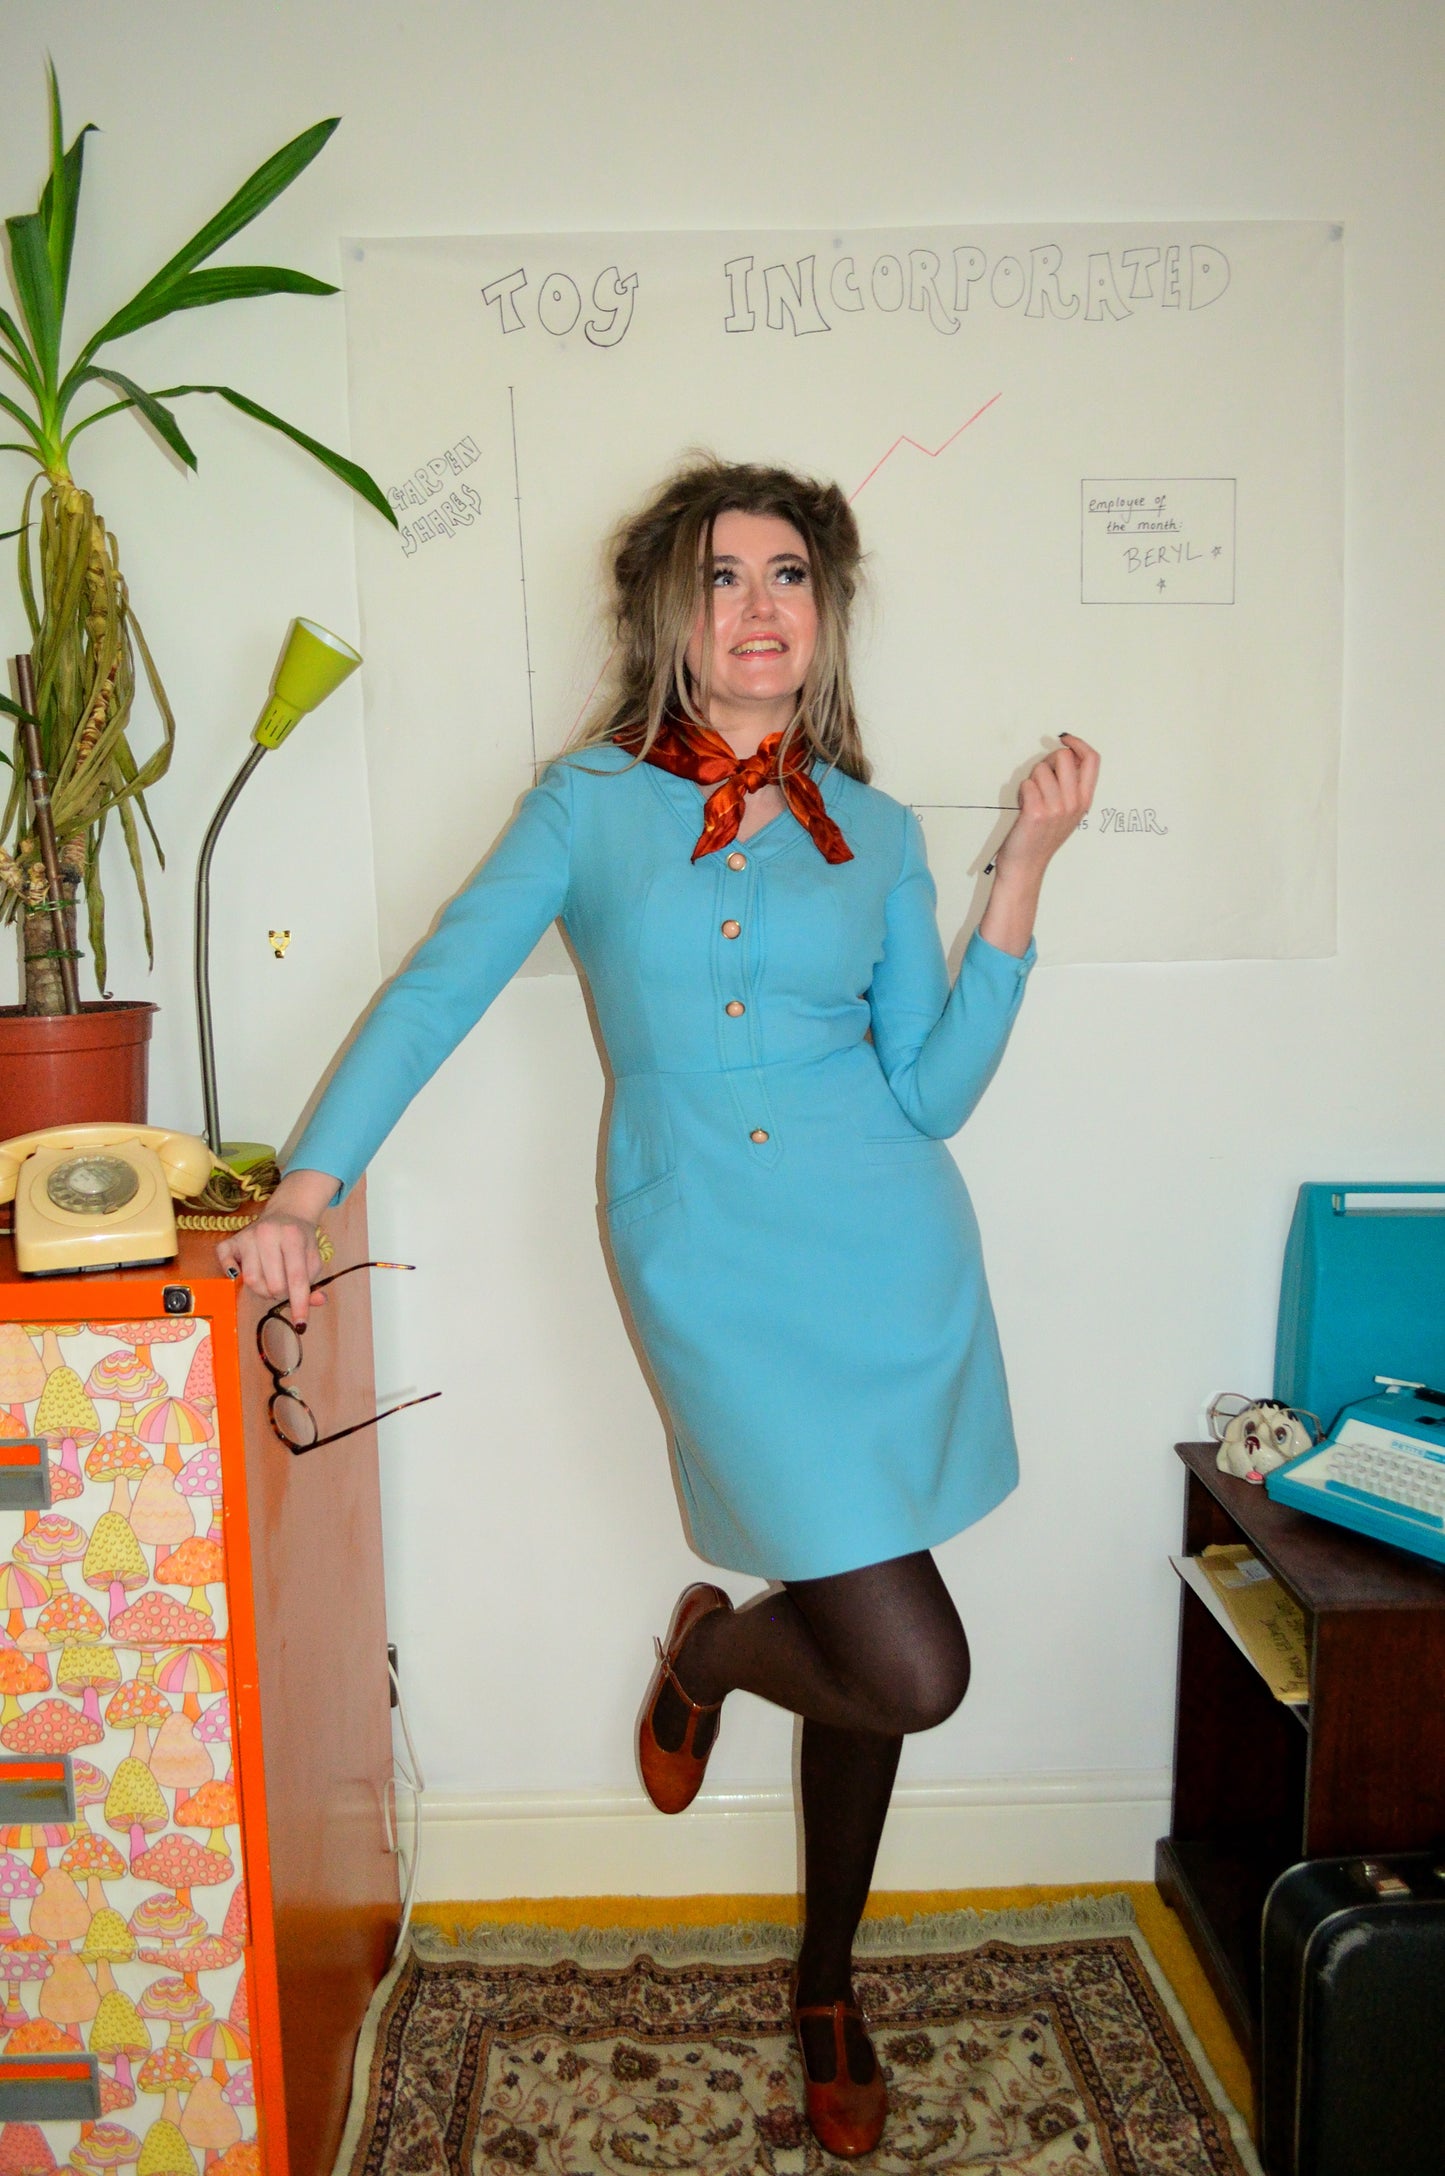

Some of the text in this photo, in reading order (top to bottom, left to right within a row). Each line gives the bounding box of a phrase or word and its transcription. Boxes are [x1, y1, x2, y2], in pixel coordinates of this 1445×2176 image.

[724, 244, 1230, 336] INCORPORATED
[386, 435, 483, 512] GARDEN
[401, 483, 482, 559] SHARES
[1088, 494, 1167, 524] employee of
[1106, 521, 1126, 532] the
[1122, 541, 1203, 574] BERYL
[1099, 807, 1169, 836] YEAR
